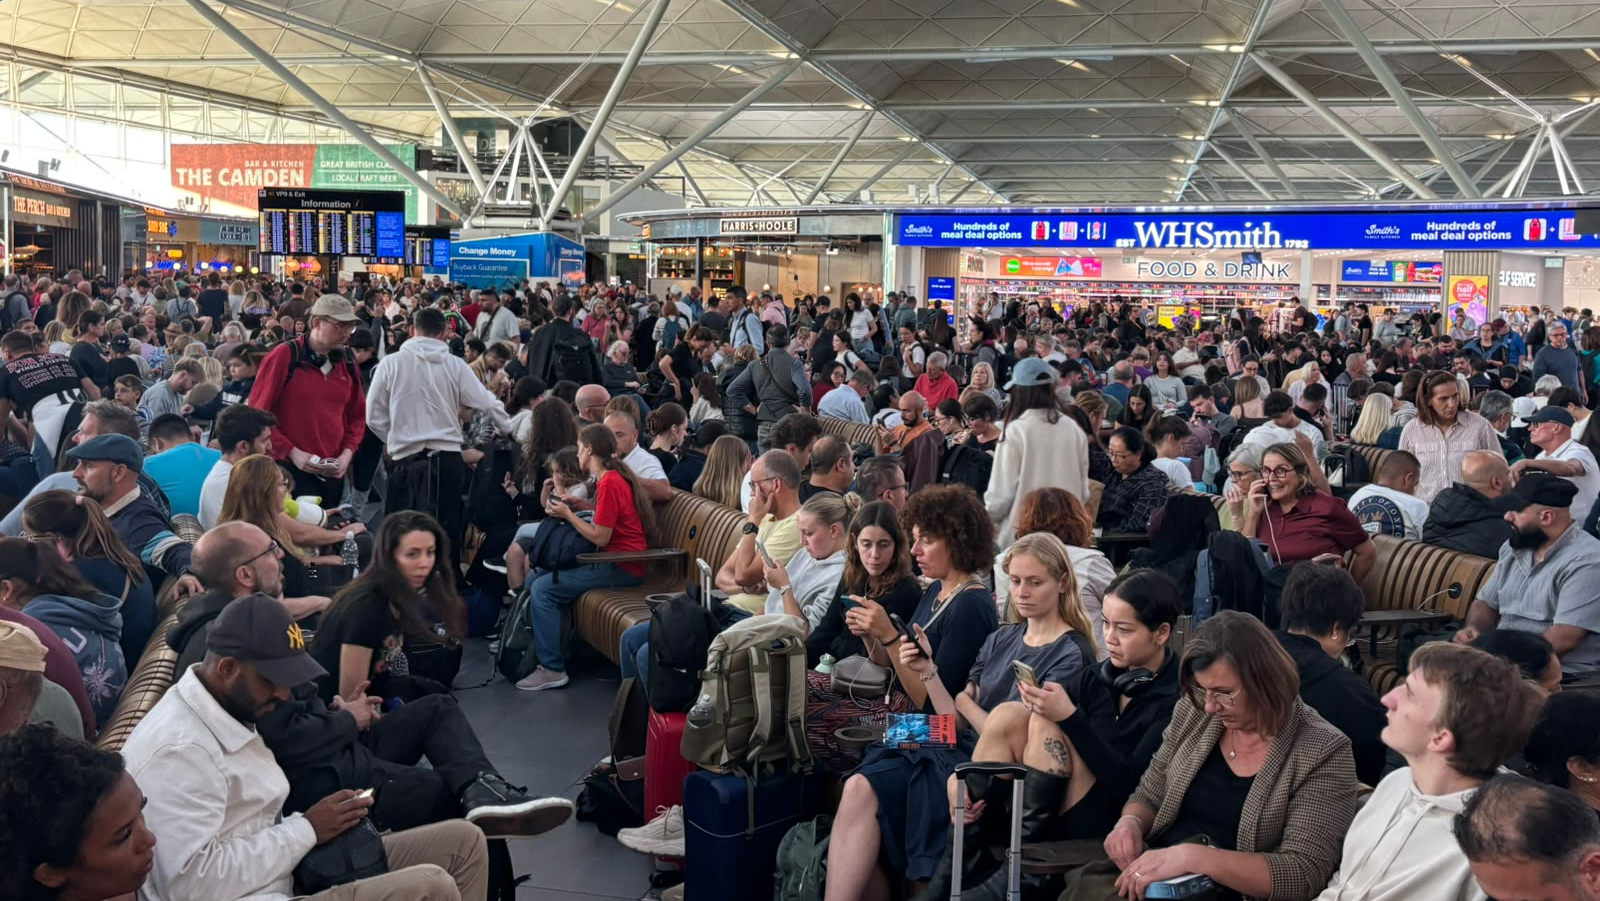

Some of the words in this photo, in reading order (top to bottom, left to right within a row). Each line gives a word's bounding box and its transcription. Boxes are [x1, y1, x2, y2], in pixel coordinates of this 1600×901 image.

[245, 160, 261, 168] BAR
[263, 160, 268, 168] &
[271, 160, 304, 168] KITCHEN
[320, 161, 344, 169] GREAT
[345, 161, 374, 169] BRITISH
[176, 168, 212, 186] THE
[218, 168, 304, 187] CAMDEN
[332, 174, 354, 182] LOCAL
[379, 174, 398, 182] BEER
[13, 195, 26, 214] THE
[27, 197, 46, 217] PERCH
[301, 199, 351, 209] Information
[723, 221, 754, 231] HARRIS
[759, 220, 793, 231] HOOLE
[905, 224, 933, 234] Smith's
[953, 222, 998, 231] Hundreds
[999, 222, 1010, 231] of
[1365, 224, 1400, 235] Smith's
[1426, 221, 1481, 231] Hundreds
[1483, 220, 1497, 231] of
[941, 231, 963, 239] meal
[965, 231, 985, 239] deal
[987, 231, 1022, 241] options
[1134, 221, 1281, 249] WHSmith
[1411, 231, 1438, 240] meal
[1440, 230, 1465, 240] deal
[1468, 230, 1512, 242] options
[1116, 238, 1136, 248] EST
[458, 246, 489, 256] Change
[491, 247, 517, 257] Money
[453, 262, 477, 271] Buyback
[479, 263, 508, 271] Guarantee
[1137, 261, 1197, 278] FOOD
[1204, 261, 1219, 278] &
[1224, 261, 1291, 279] DRINK
[1499, 270, 1510, 286] ELF
[1510, 270, 1537, 288] SERVICE
[1457, 285, 1473, 293] half
[15, 362, 44, 374] WEMBLEY
